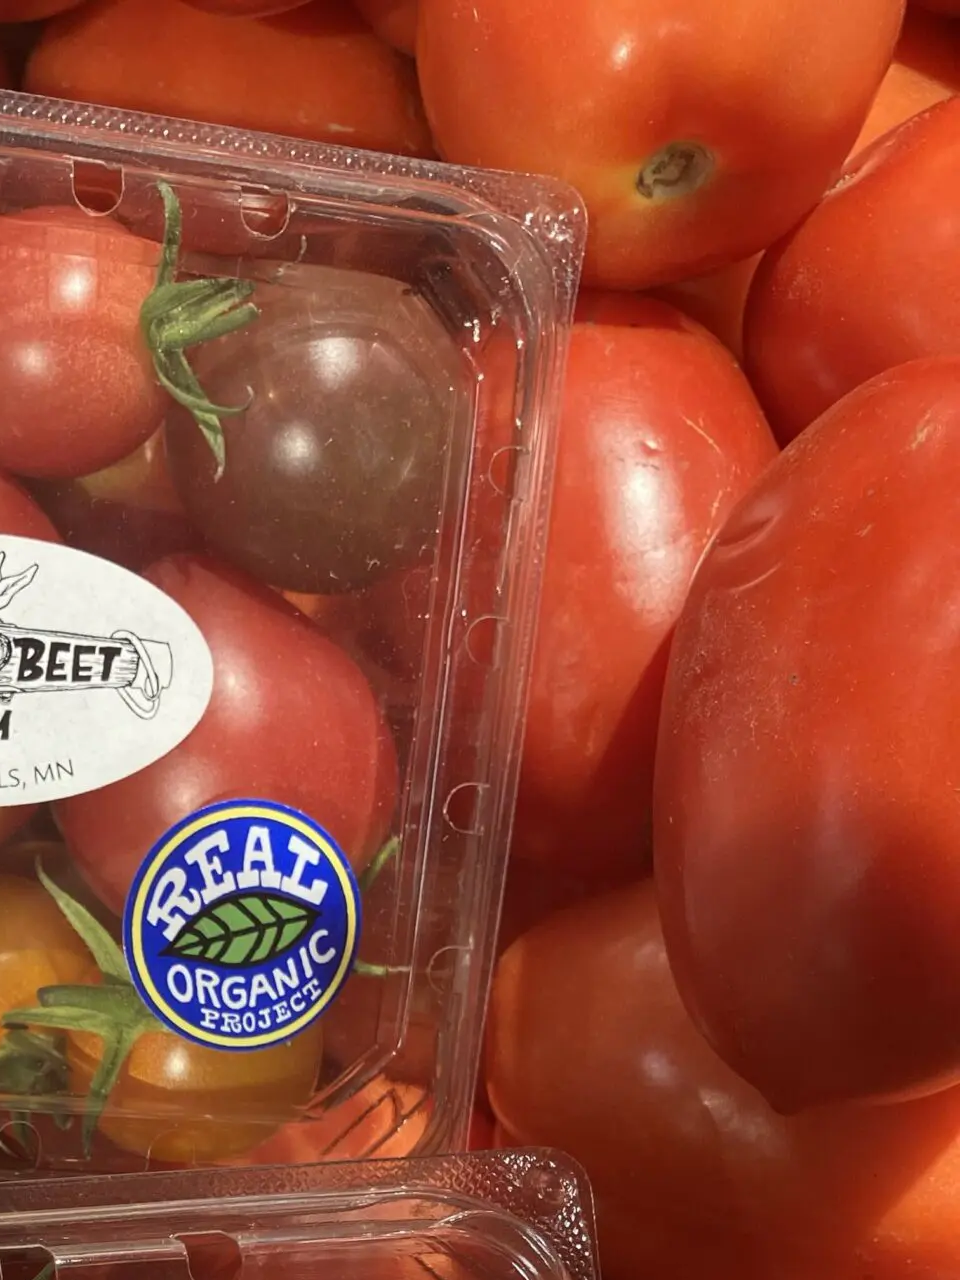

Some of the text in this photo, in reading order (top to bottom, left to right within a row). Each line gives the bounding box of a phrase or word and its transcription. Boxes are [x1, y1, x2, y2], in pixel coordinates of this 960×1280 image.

[13, 637, 123, 682] BEET
[34, 758, 75, 782] MN
[146, 826, 328, 941] REAL
[167, 929, 336, 1010] ORGANIC
[200, 979, 322, 1033] PROJECT
